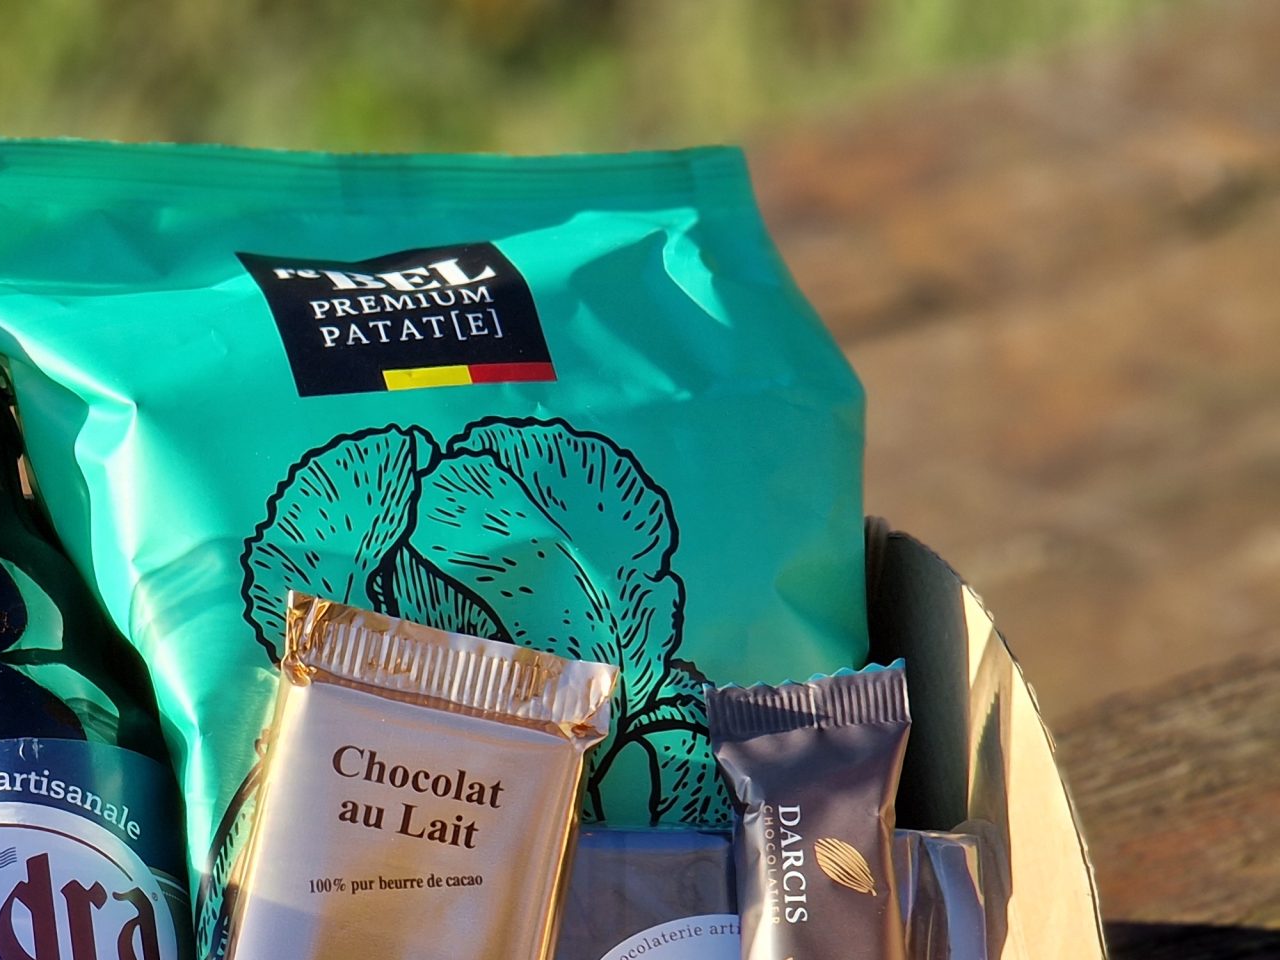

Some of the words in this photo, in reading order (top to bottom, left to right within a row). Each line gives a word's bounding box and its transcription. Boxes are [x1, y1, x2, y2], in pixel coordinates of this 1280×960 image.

[273, 257, 496, 291] reBEL
[310, 286, 494, 320] PREMIUM
[320, 308, 503, 348] PATAT[E]
[332, 744, 505, 809] Chocolat
[338, 800, 384, 830] au
[396, 803, 480, 850] Lait
[308, 877, 346, 894] 100%
[351, 878, 376, 895] pur
[378, 873, 424, 891] beurre
[426, 873, 443, 889] de
[445, 873, 483, 888] cacao
[763, 804, 781, 924] CHOCOLATIER
[778, 804, 808, 924] DARCIS
[709, 923, 741, 936] arti
